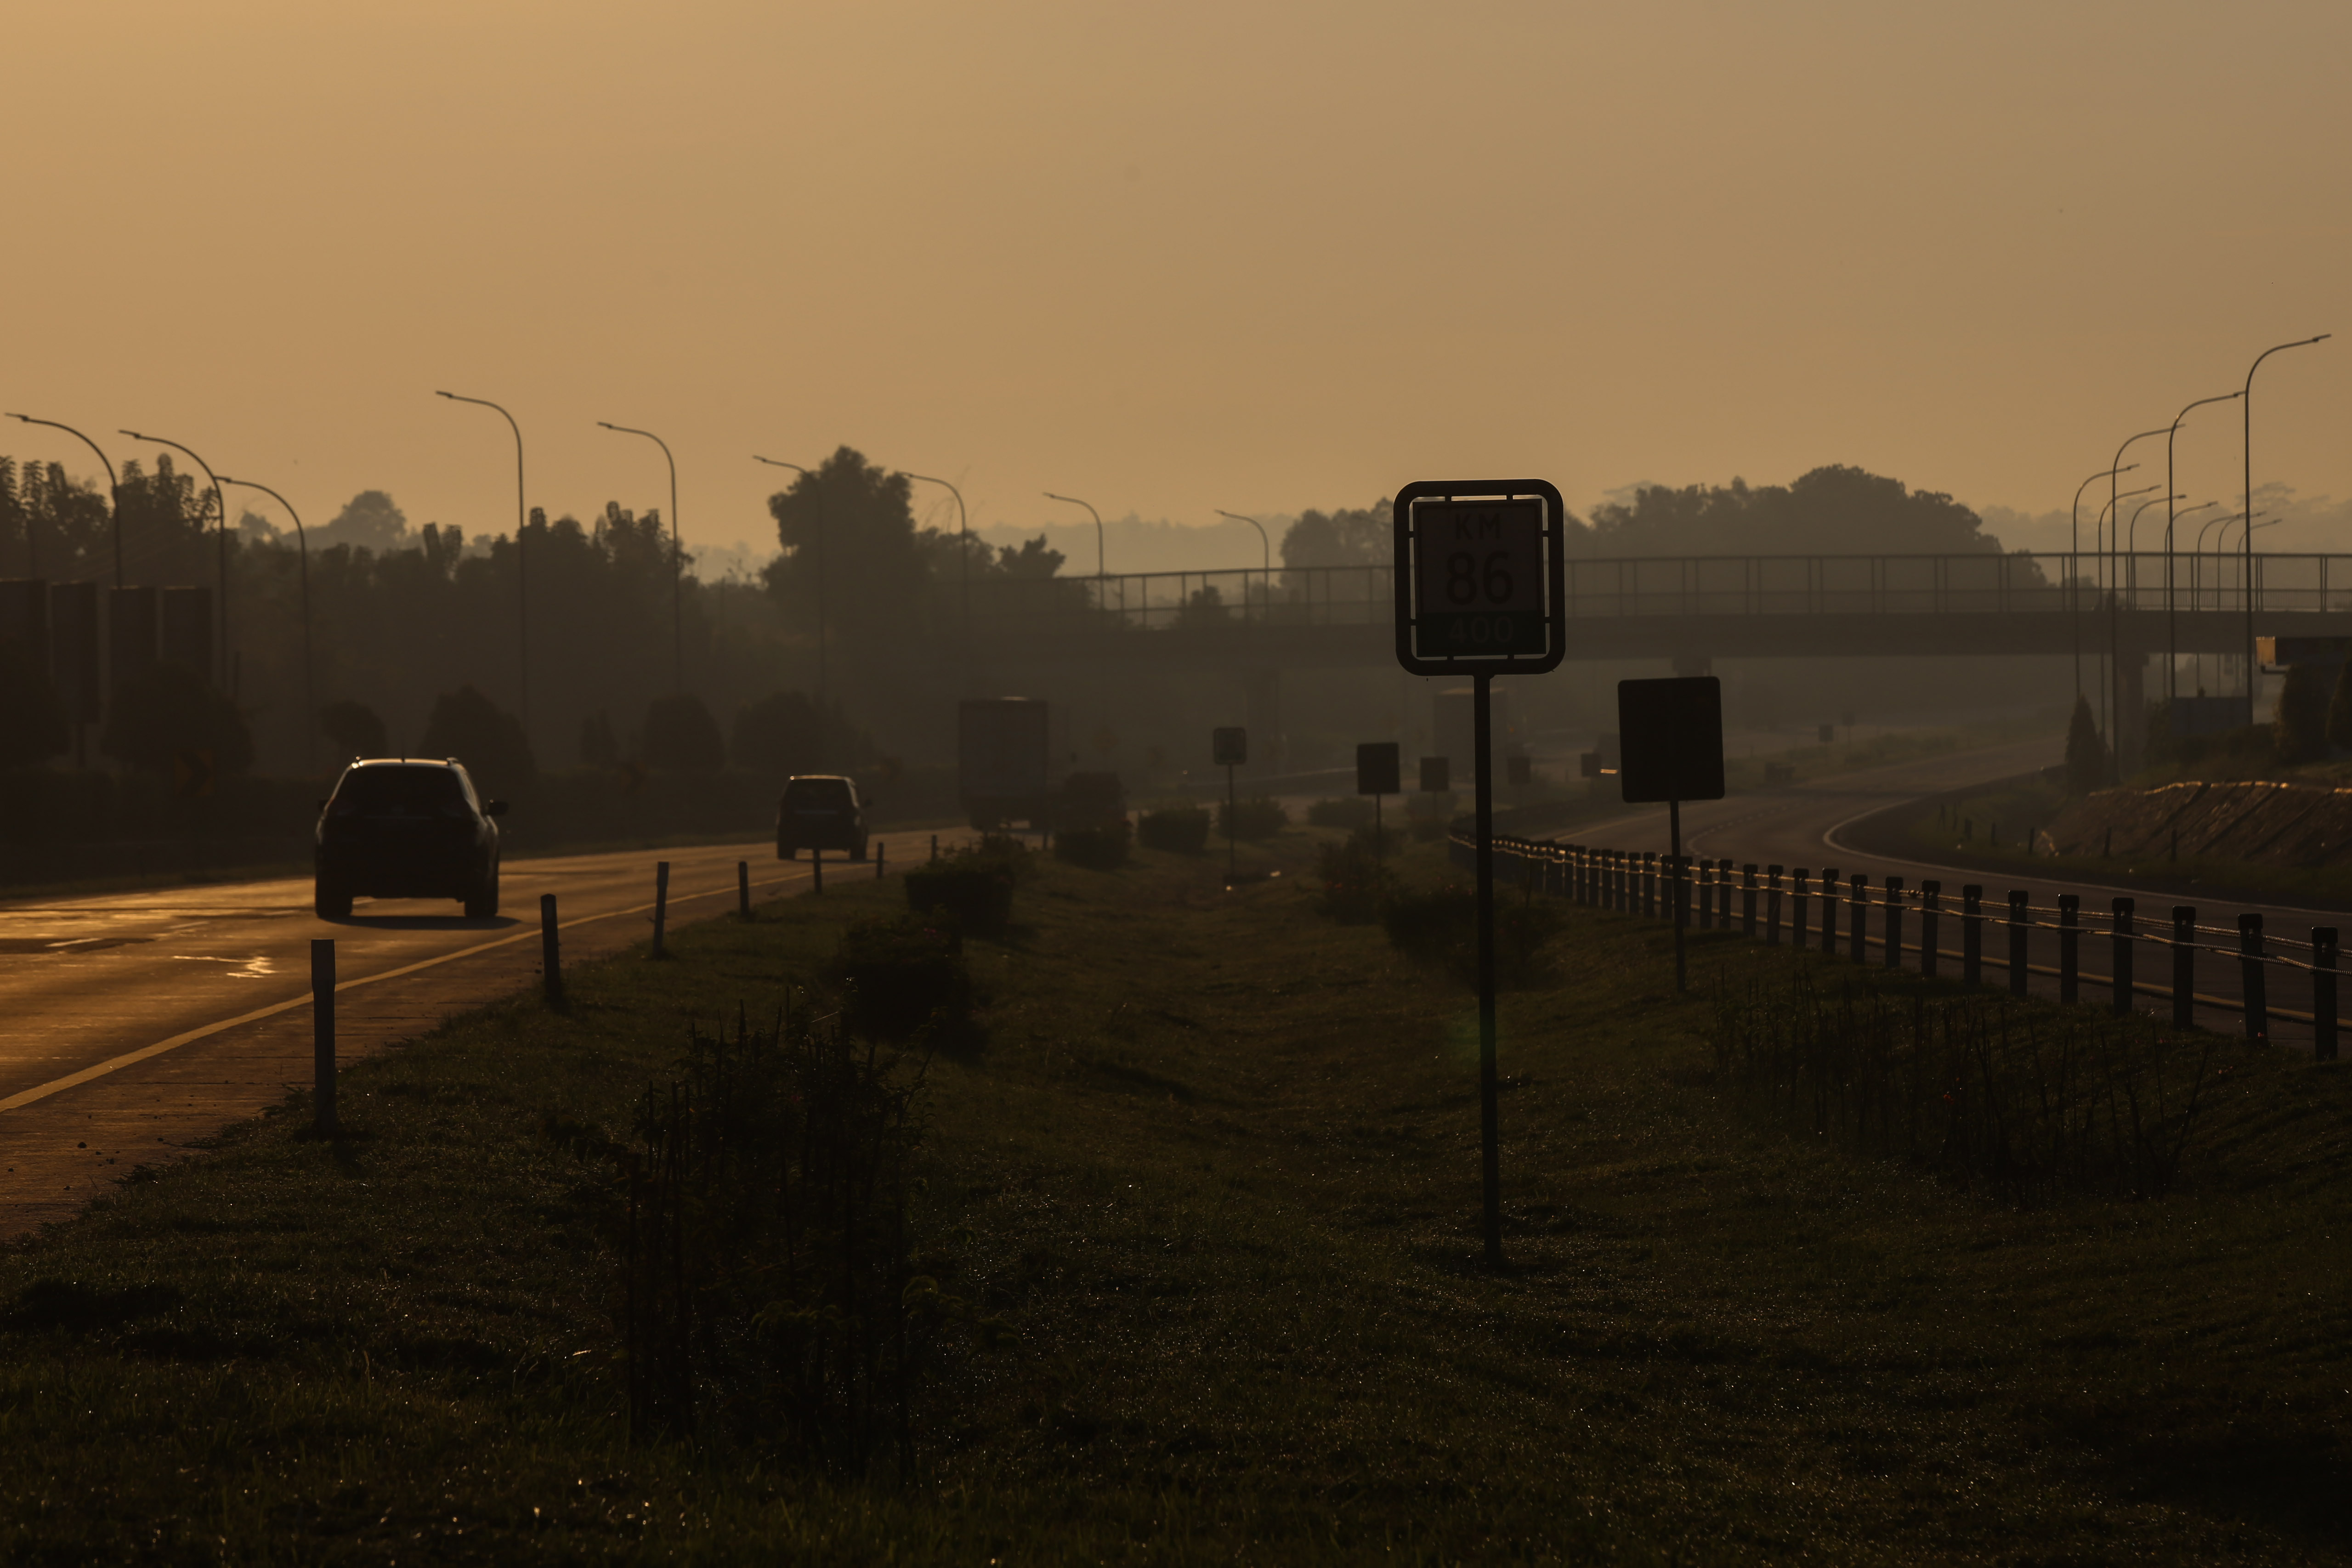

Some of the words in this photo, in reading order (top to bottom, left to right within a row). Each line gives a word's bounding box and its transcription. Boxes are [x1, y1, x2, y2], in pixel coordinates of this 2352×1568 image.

[1455, 513, 1501, 539] KM
[1446, 551, 1513, 605] 86
[1448, 616, 1514, 644] 400
